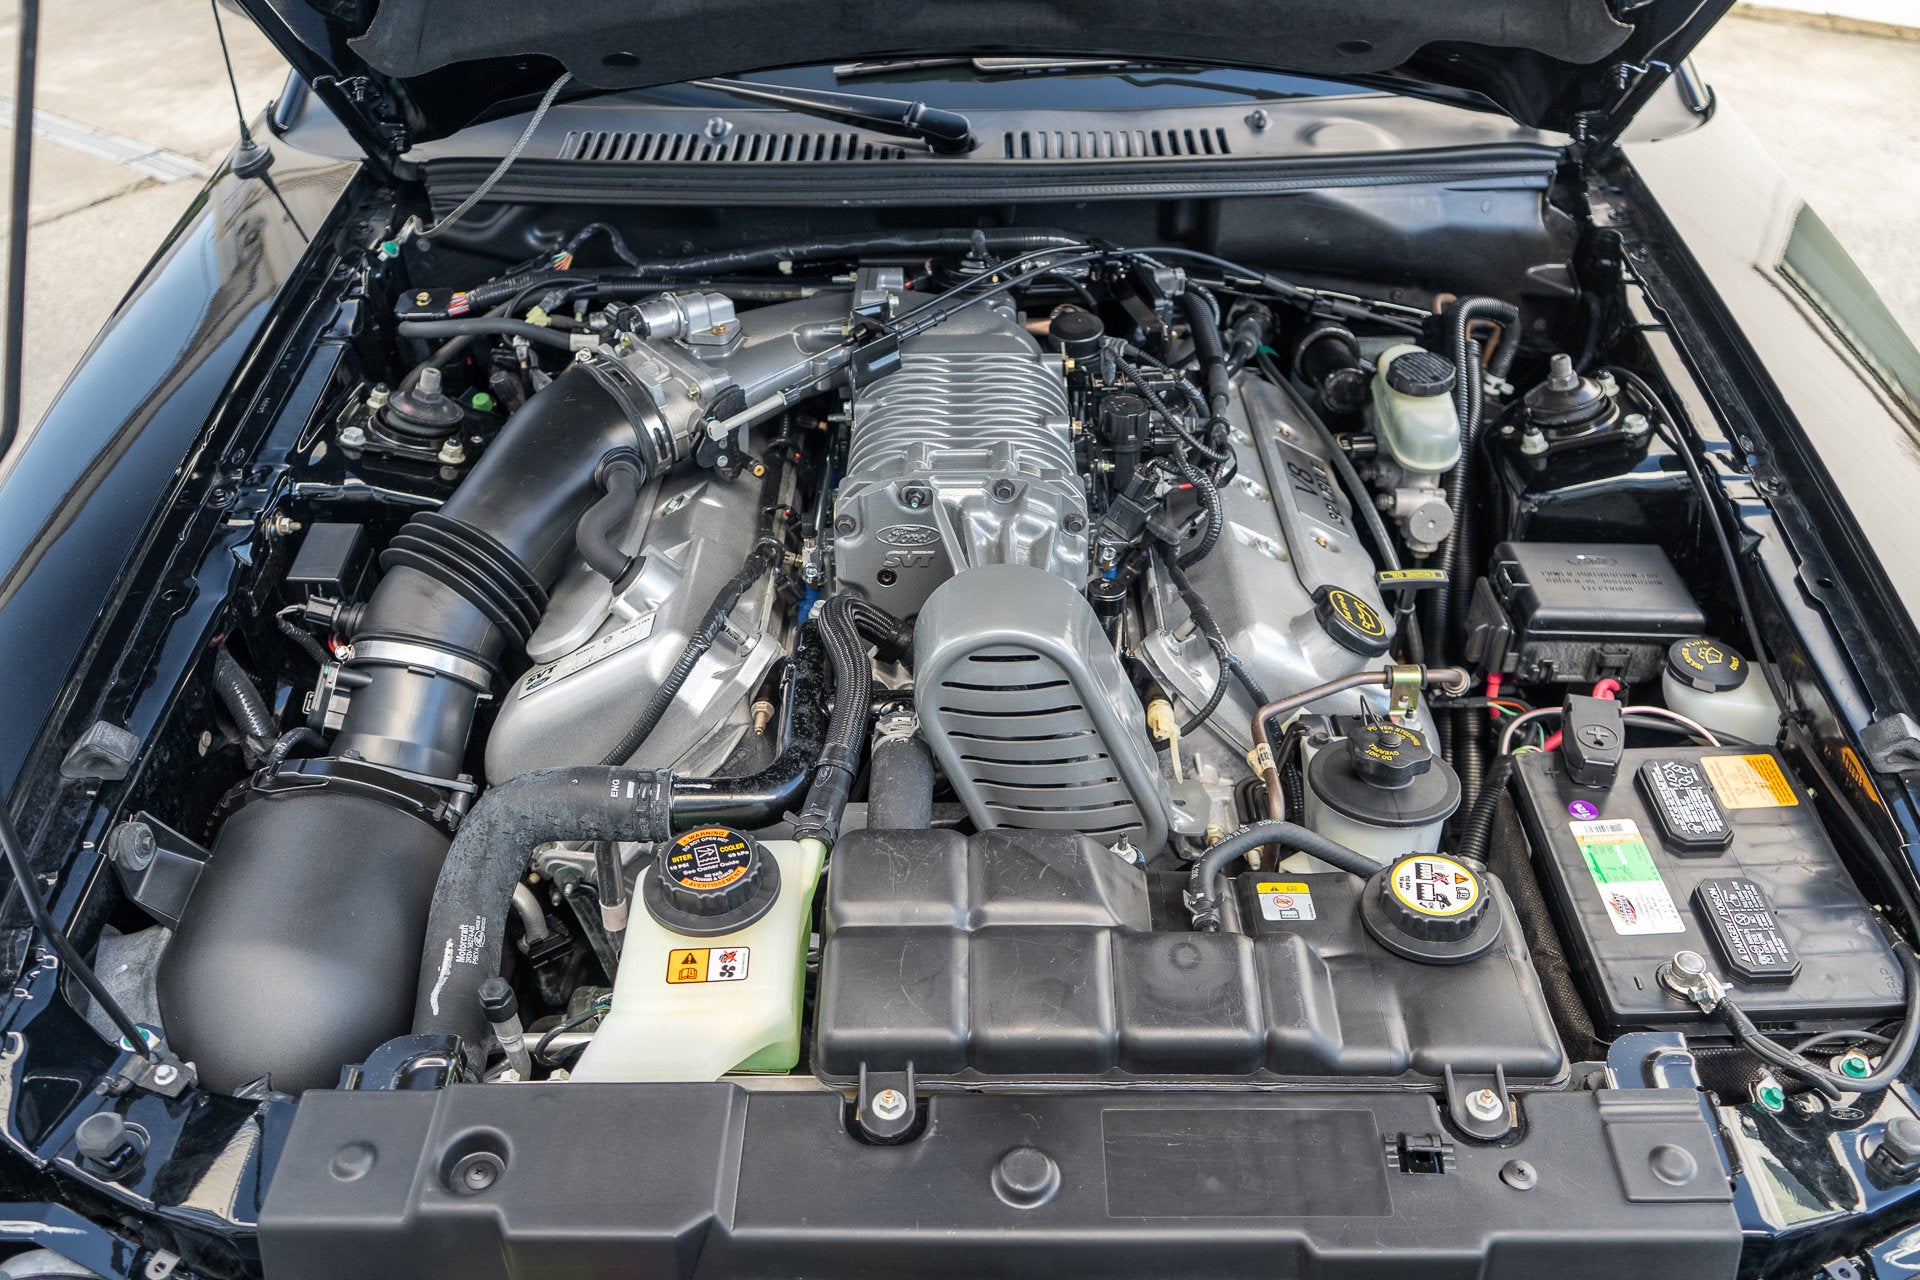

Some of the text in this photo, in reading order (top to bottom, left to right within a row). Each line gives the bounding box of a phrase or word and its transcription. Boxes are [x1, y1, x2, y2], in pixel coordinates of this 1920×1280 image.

[1287, 461, 1318, 496] V8
[882, 525, 934, 543] Ford
[883, 550, 935, 568] SVT
[526, 665, 557, 686] SVT
[1365, 749, 1380, 758] NOT
[610, 779, 620, 797] ENG
[688, 830, 725, 840] WARNING
[671, 843, 745, 863] INTER COOLER
[697, 864, 719, 873] Owner
[720, 859, 740, 867] Guide
[689, 869, 743, 888] AVERTISSEMENT
[1707, 887, 1728, 915] POISON
[456, 924, 468, 963] Motorcraft
[1725, 922, 1747, 954] DANGER
